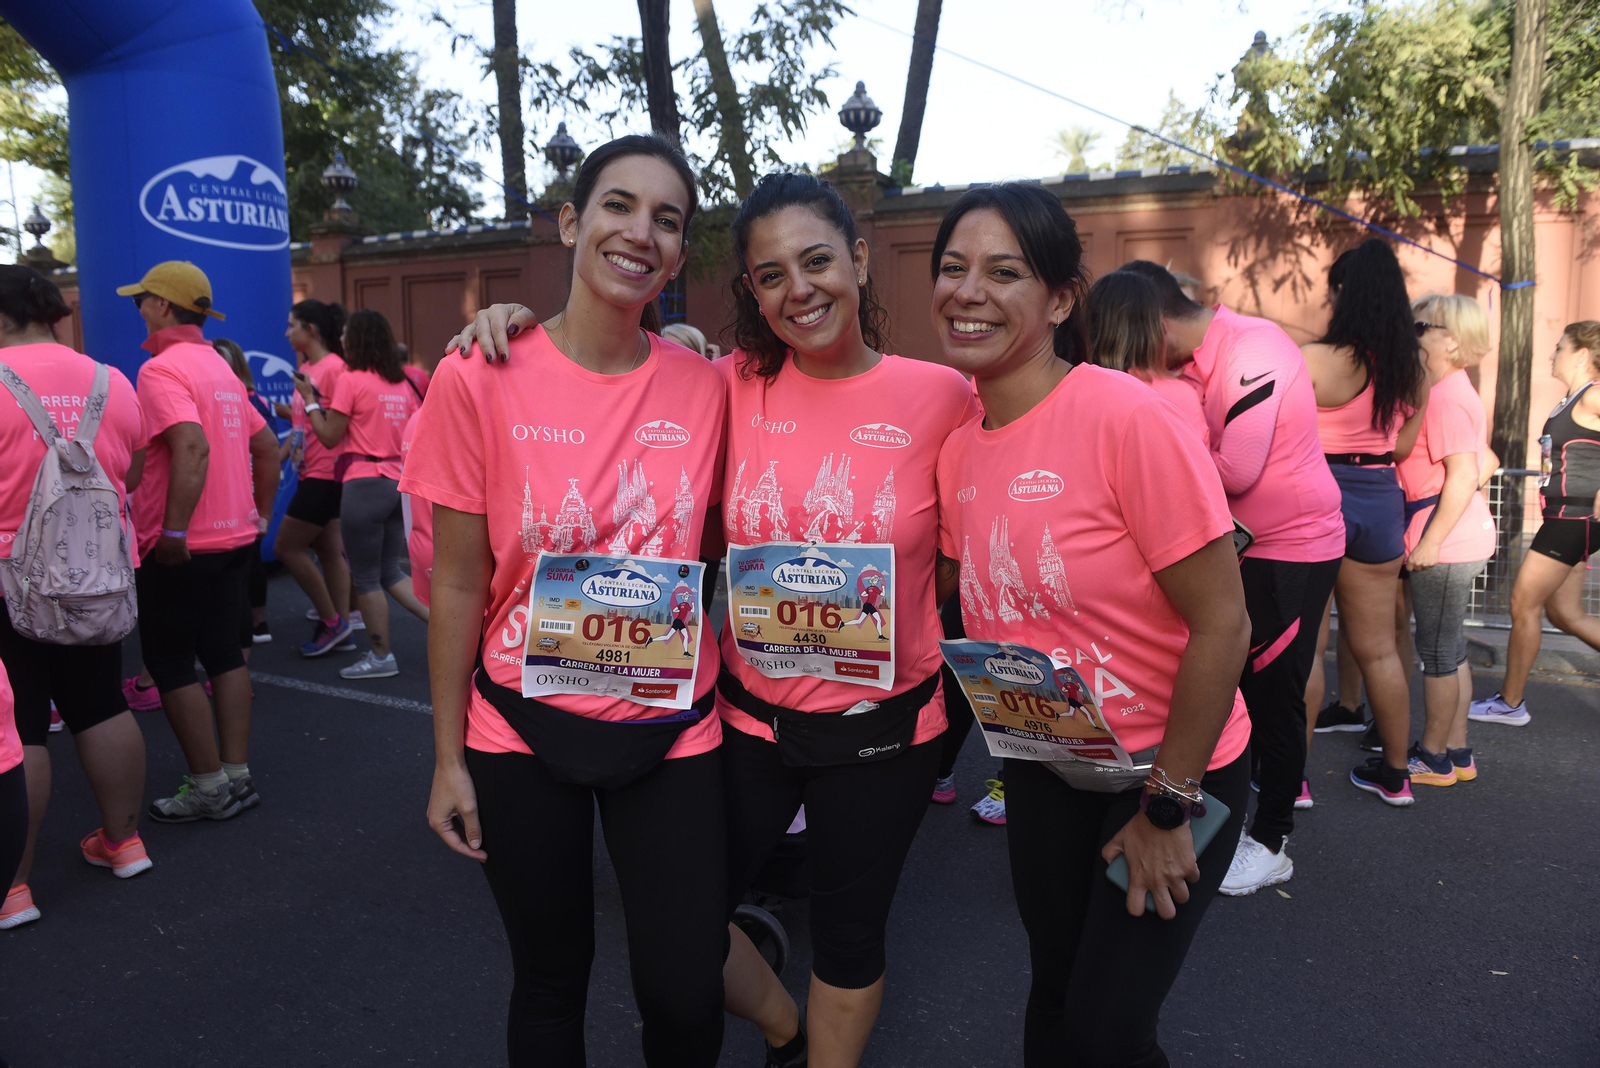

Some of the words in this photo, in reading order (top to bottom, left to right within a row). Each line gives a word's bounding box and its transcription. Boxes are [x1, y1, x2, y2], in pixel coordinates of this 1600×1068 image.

[189, 183, 252, 199] CENTRAL
[512, 424, 585, 445] OYSHO
[640, 430, 687, 442] ASTURIANA
[854, 430, 907, 445] ASTURIANA
[1011, 482, 1059, 495] ASTURIANA
[738, 563, 765, 573] SUMA
[546, 572, 575, 582] SUMA
[776, 568, 842, 586] ASTURIANA
[586, 580, 656, 601] ASTURIANA
[776, 600, 842, 629] 016
[582, 613, 652, 645] 016
[793, 632, 826, 645] 4430
[490, 649, 522, 667] CARRER
[595, 648, 631, 664] 4981
[763, 643, 801, 653] CARRERA
[803, 645, 815, 653] DE
[817, 646, 827, 655] LA
[829, 648, 858, 658] MUJER
[559, 658, 600, 672] CARRERA
[603, 665, 615, 673] DE
[617, 666, 629, 675] LA
[631, 667, 661, 677] MUJER
[750, 656, 796, 671] OYSHO
[847, 666, 874, 675] Santander
[990, 661, 1042, 681] ASTURIANA
[536, 673, 590, 687] OYSHO
[1000, 690, 1056, 719] 016
[1120, 702, 1146, 716] 2022
[1024, 719, 1053, 733] 4976
[1005, 726, 1036, 740] CARRERA
[1036, 732, 1048, 741] DE
[1048, 734, 1057, 743] LA
[1057, 736, 1086, 745] MUJER
[997, 739, 1038, 755] OYSHO
